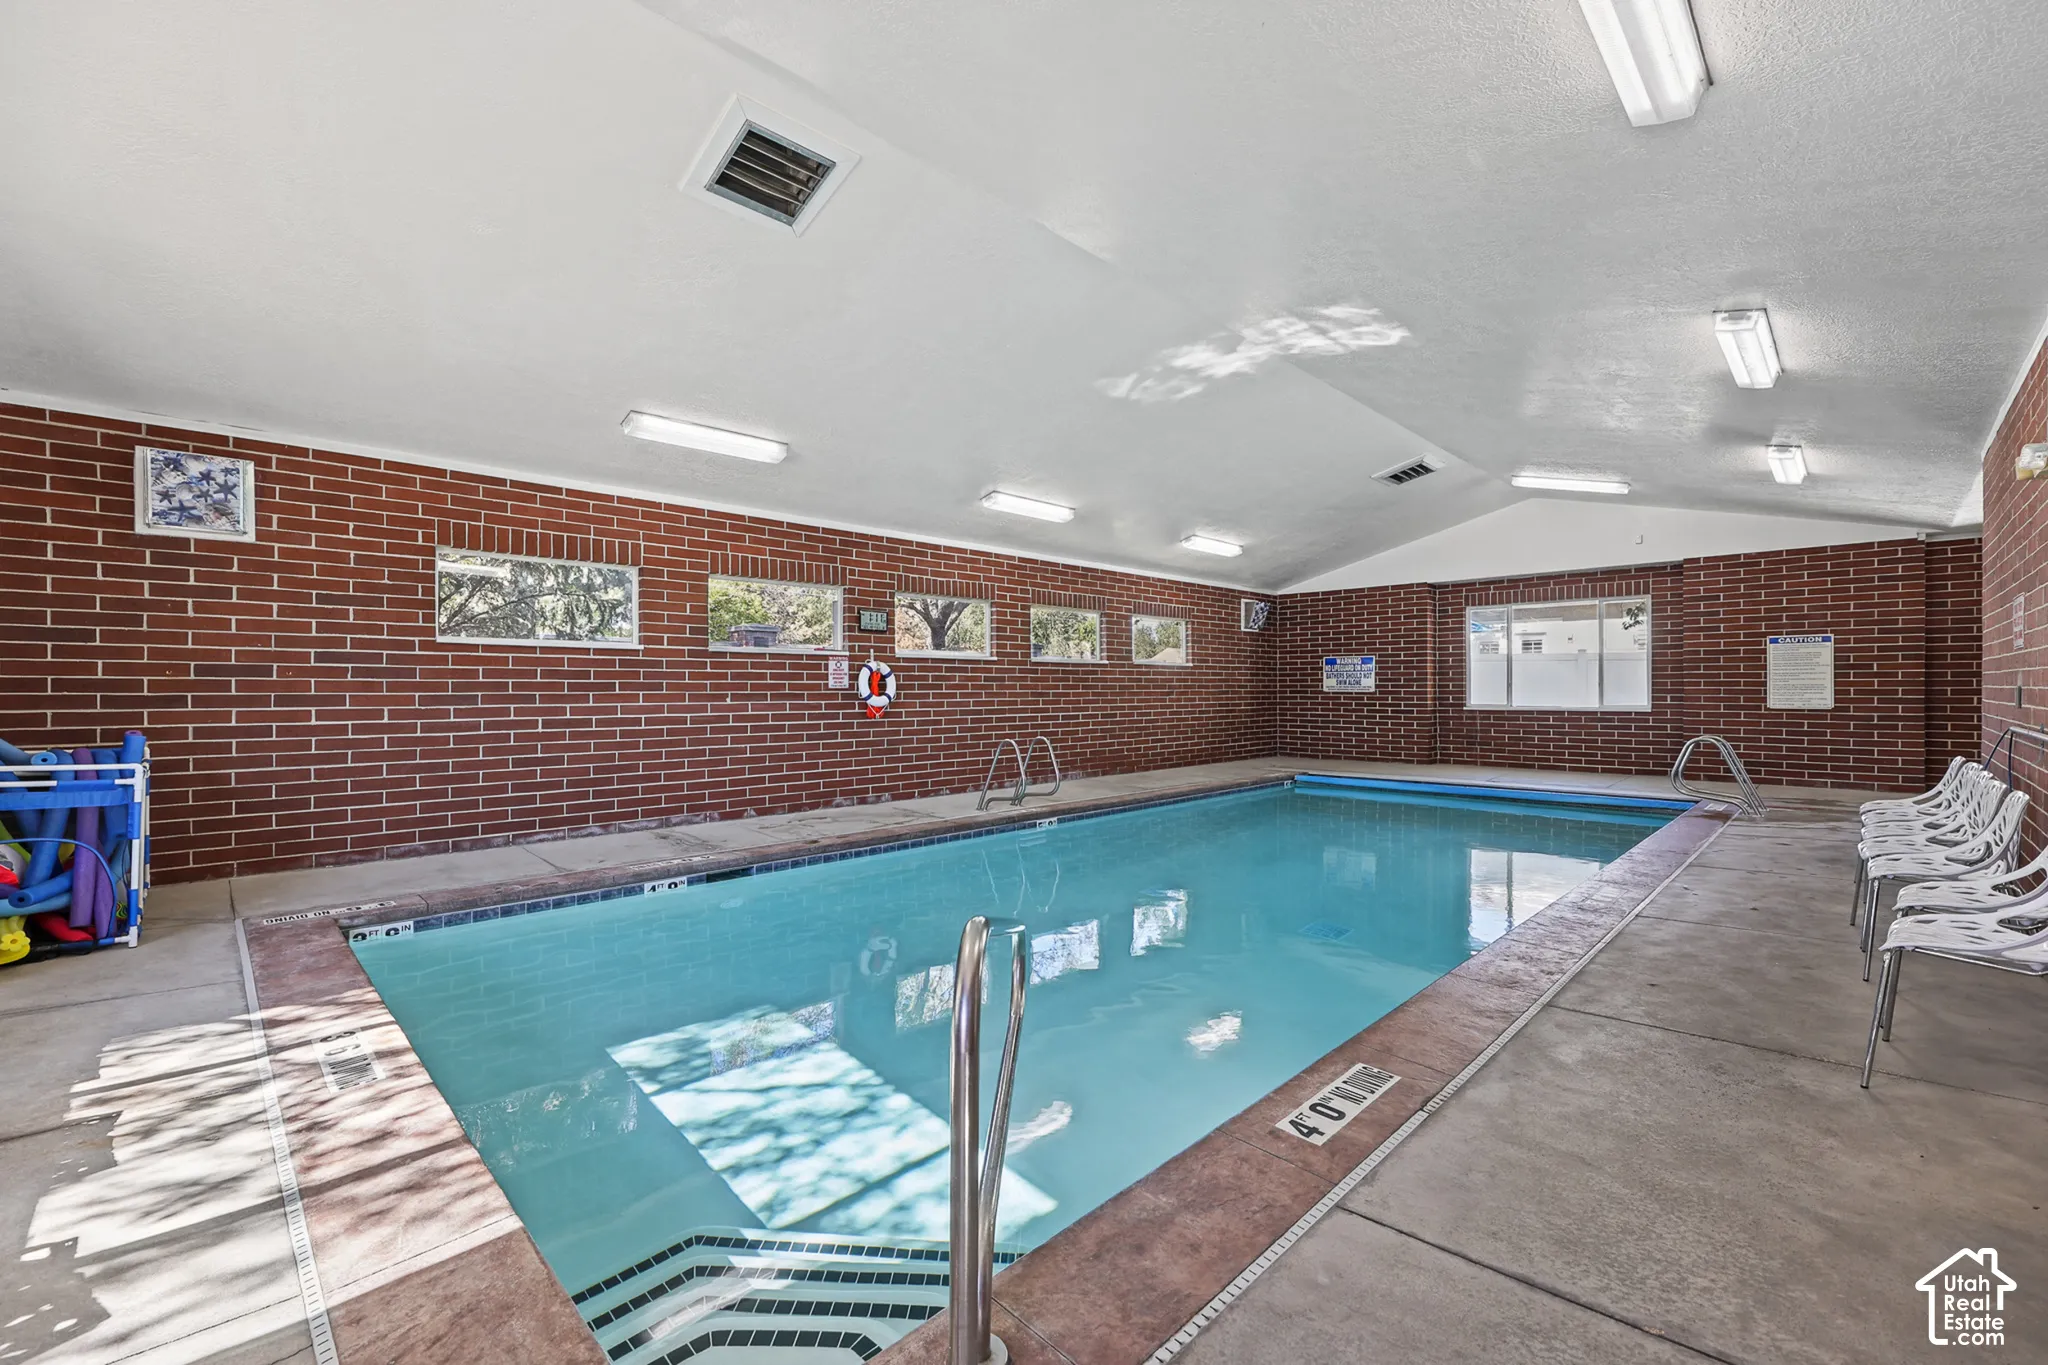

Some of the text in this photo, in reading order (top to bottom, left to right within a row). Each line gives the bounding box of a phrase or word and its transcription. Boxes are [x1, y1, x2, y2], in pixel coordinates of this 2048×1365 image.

[1778, 636, 1823, 644] CAUTION
[1341, 1066, 1395, 1095] DIVING
[1327, 1086, 1368, 1106] NO
